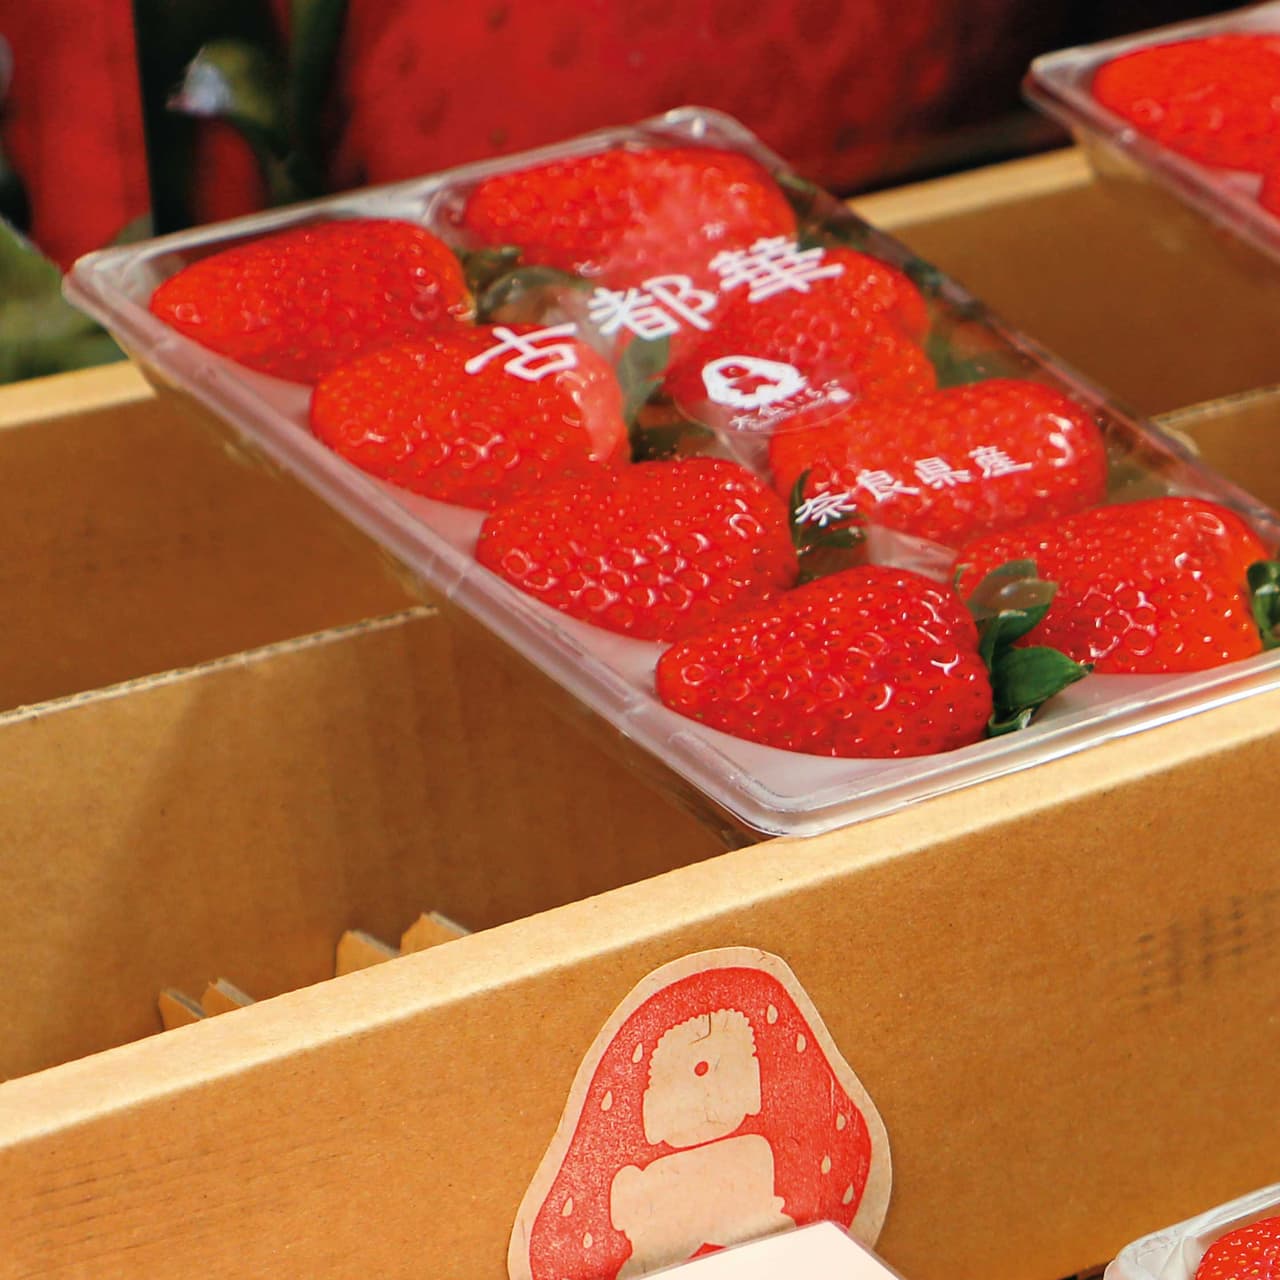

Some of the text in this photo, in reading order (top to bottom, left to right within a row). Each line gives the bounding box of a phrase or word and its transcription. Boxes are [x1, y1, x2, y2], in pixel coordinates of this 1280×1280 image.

[464, 236, 845, 381] 古都華
[795, 445, 1033, 527] 奈良県産
